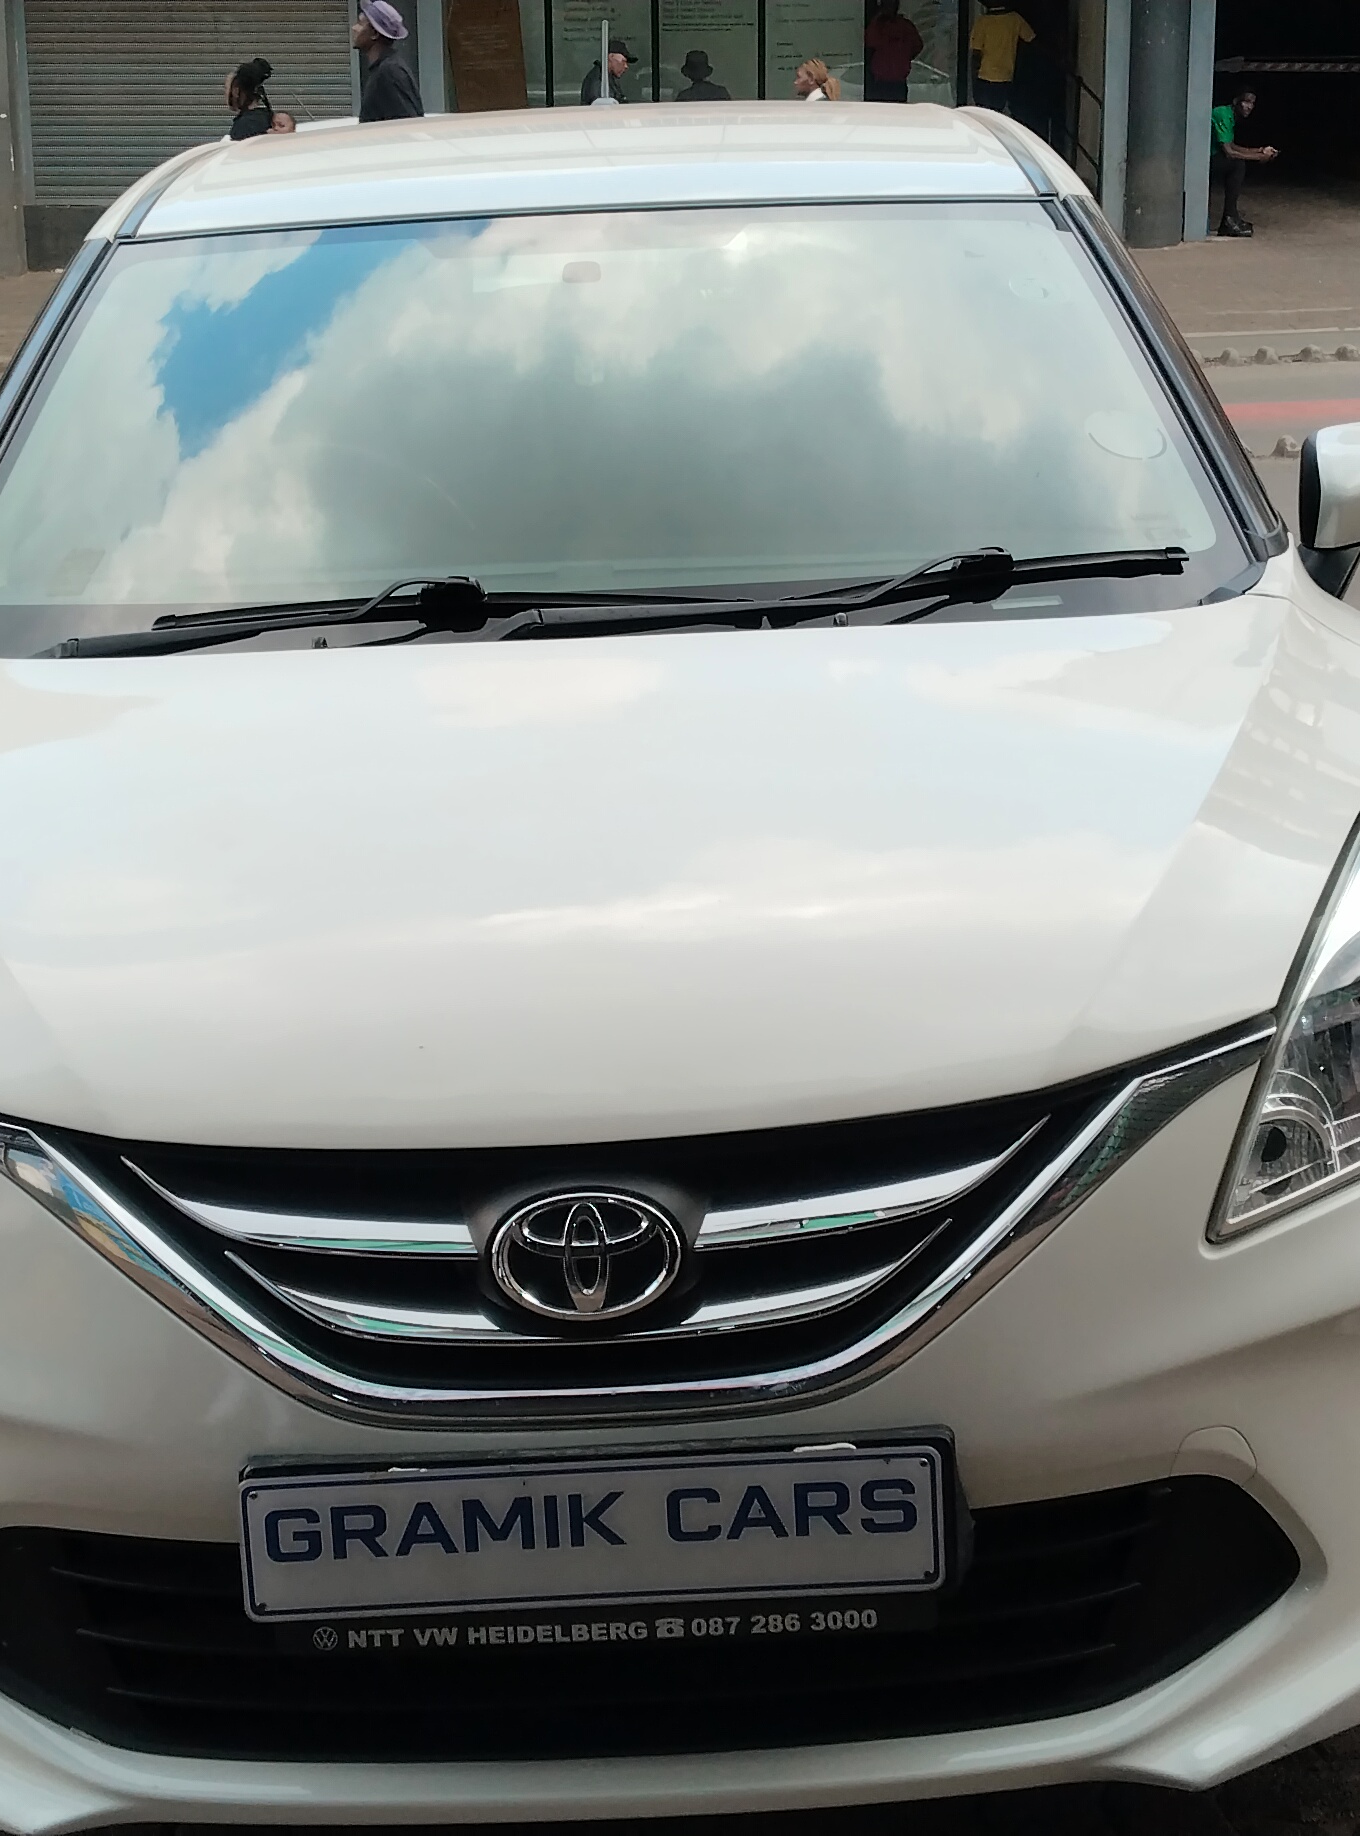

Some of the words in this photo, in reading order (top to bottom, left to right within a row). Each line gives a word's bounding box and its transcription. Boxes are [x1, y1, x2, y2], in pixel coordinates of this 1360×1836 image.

[264, 1491, 627, 1563] GRAMIK
[665, 1478, 919, 1543] CARS
[347, 1628, 405, 1650] NTT
[413, 1626, 459, 1648] VW
[467, 1620, 648, 1646] HEIDELBERG
[690, 1616, 741, 1638] 087
[750, 1613, 802, 1635] 286
[809, 1608, 878, 1633] 3000
